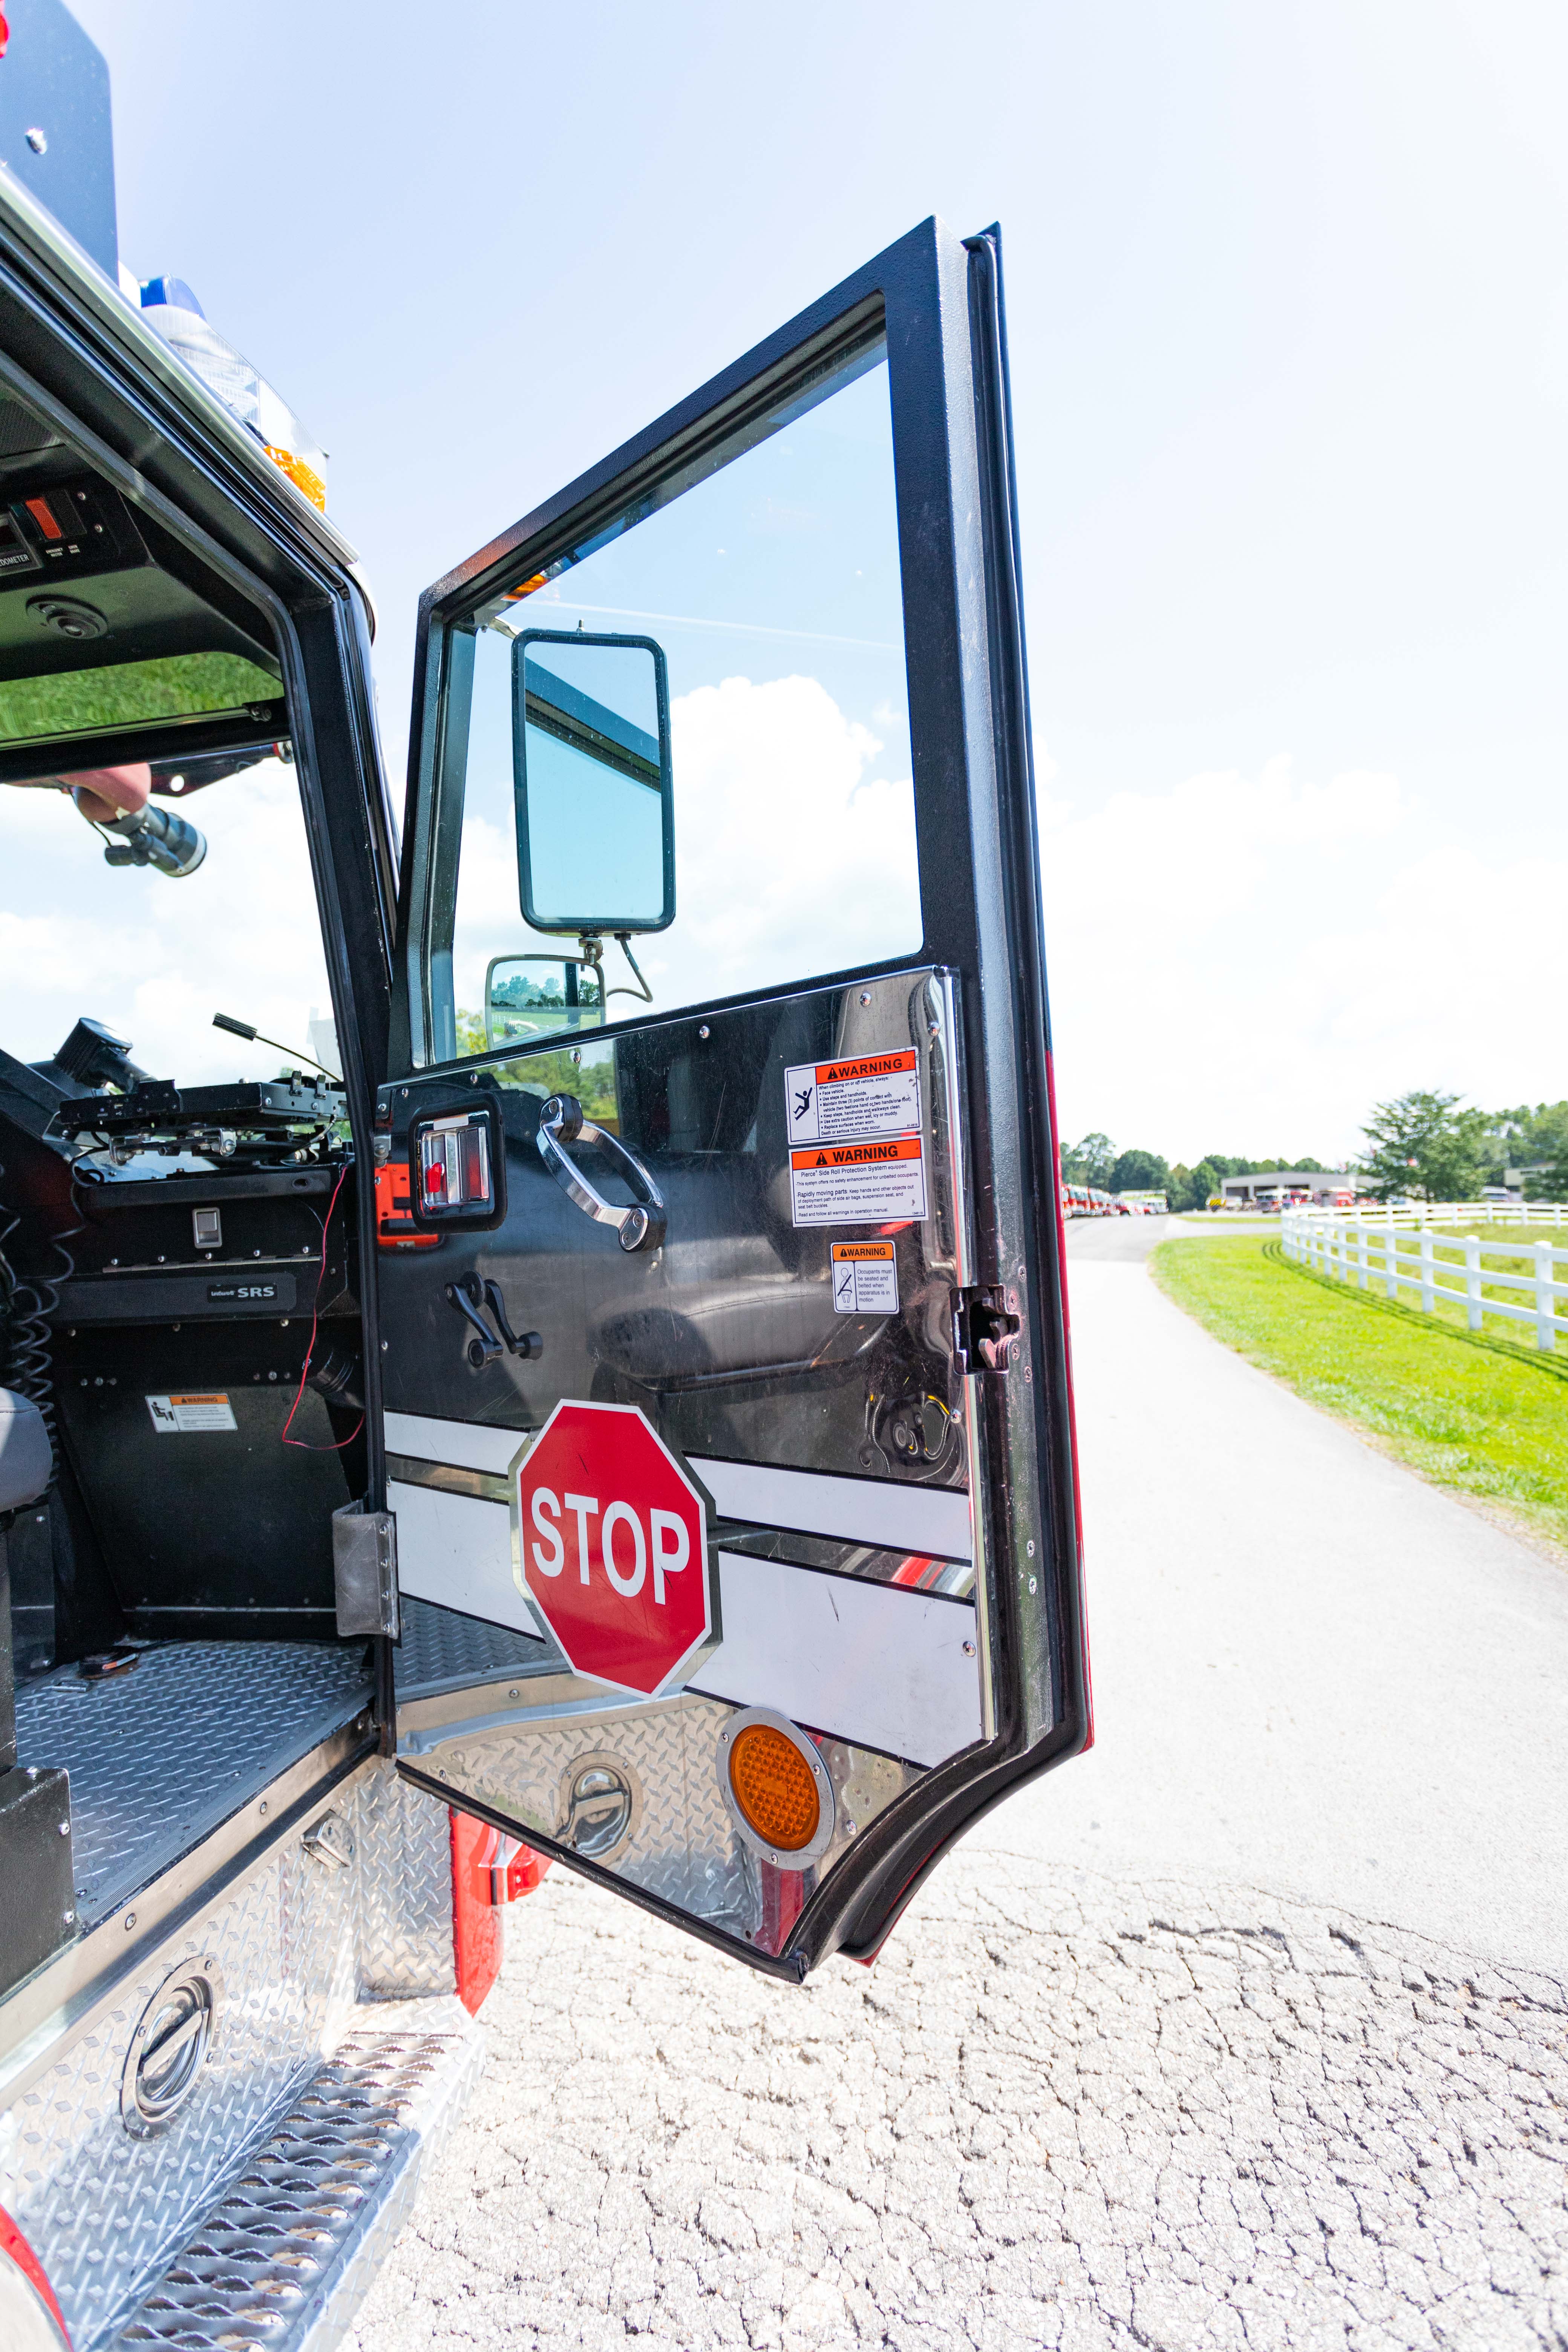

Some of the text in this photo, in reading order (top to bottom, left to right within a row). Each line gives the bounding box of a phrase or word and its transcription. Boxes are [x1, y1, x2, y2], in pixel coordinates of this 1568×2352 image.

[839, 1059, 902, 1077] WARNING
[833, 1145, 898, 1162] WARNING
[847, 1248, 886, 1256] WARNING
[237, 1286, 274, 1298] SRS
[531, 1487, 690, 1605] STOP
